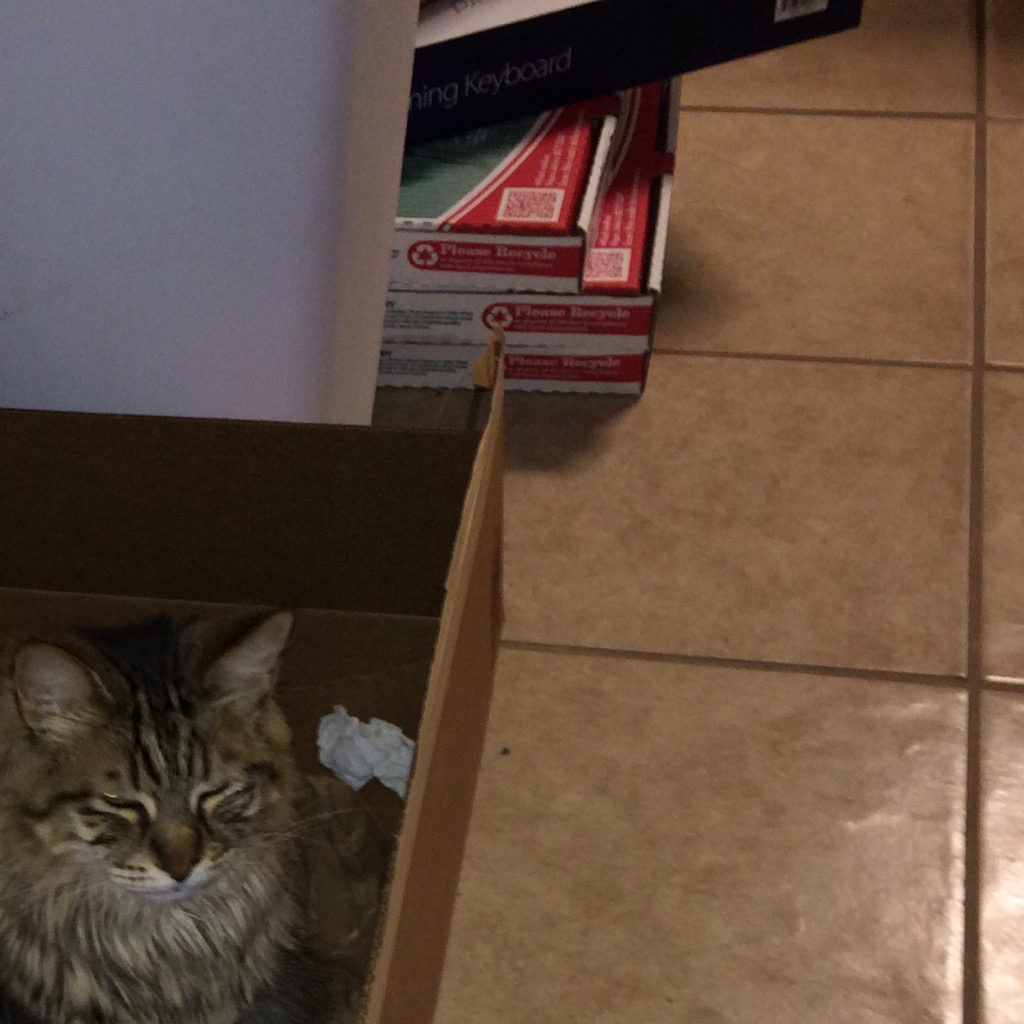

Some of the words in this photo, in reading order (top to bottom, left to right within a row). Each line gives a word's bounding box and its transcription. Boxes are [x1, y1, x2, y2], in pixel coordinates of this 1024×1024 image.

[465, 46, 573, 97] Keyboard
[440, 243, 492, 257] Please
[495, 245, 557, 260] Recycle
[514, 304, 566, 318] Please
[570, 306, 631, 320] Recycle
[562, 357, 622, 370] Recycle
